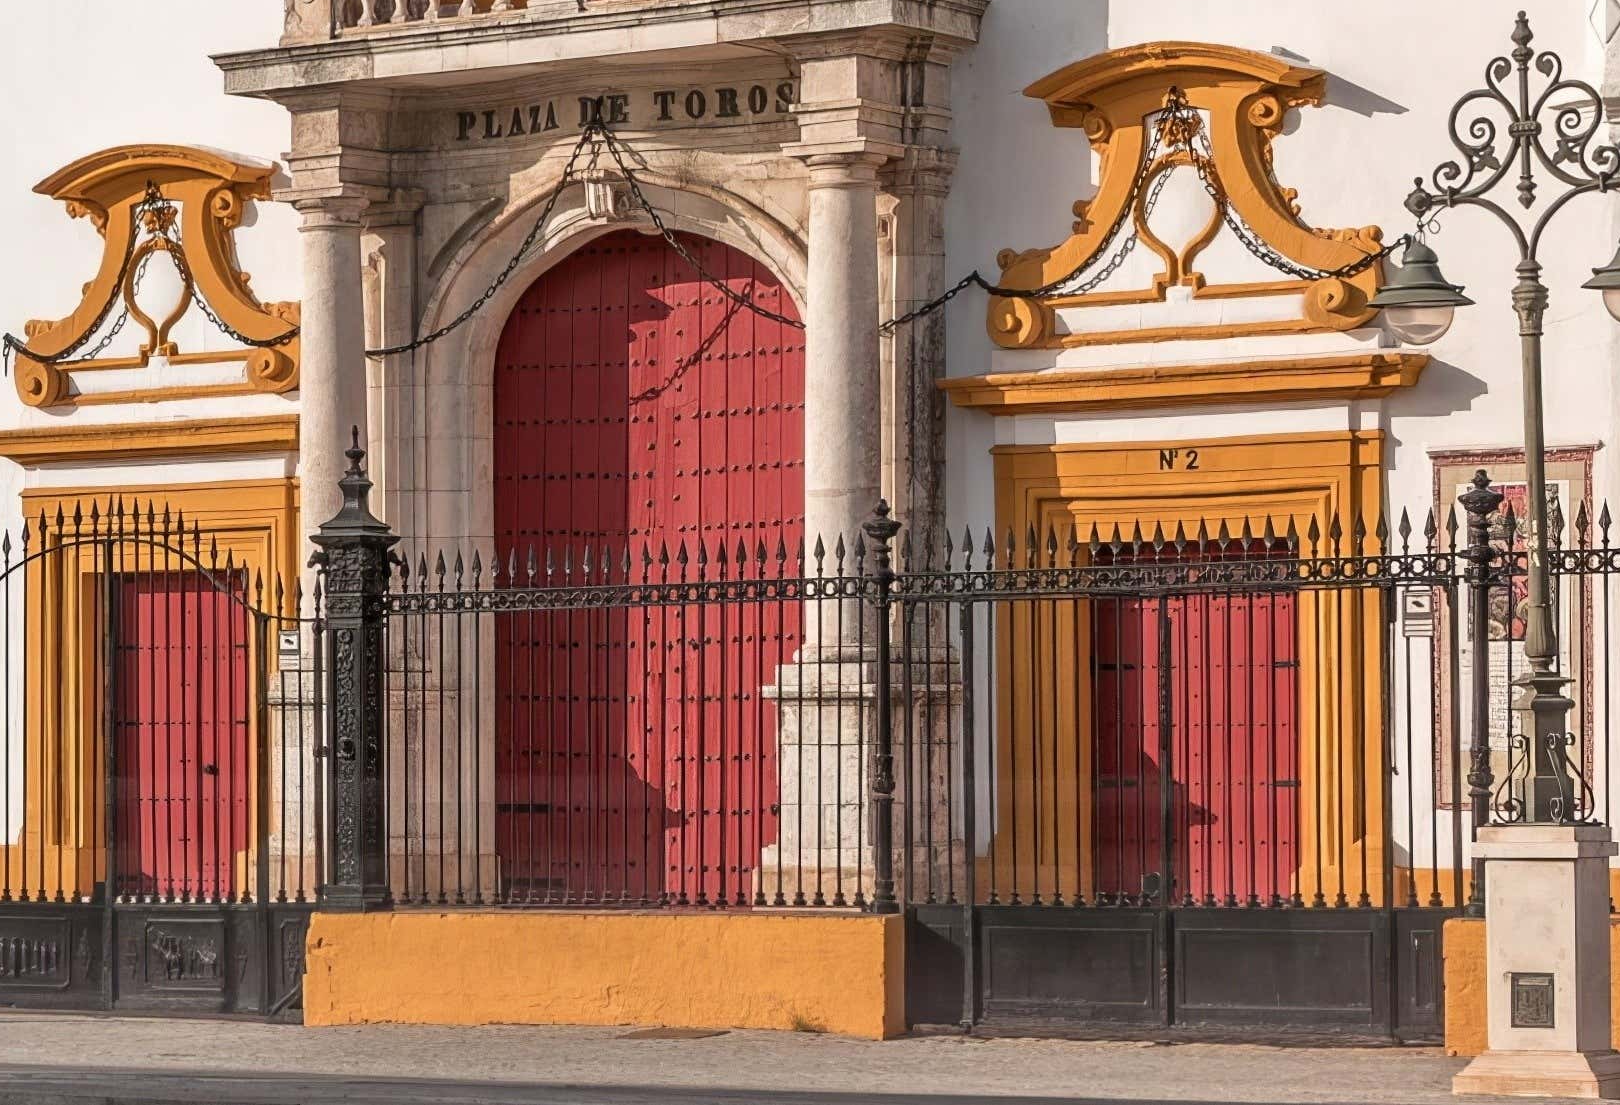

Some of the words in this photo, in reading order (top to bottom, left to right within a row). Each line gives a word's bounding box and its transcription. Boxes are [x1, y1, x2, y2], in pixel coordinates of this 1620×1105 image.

[455, 100, 560, 142] PLAZA
[578, 94, 630, 128] DE
[653, 81, 794, 122] TOROS
[1185, 448, 1200, 471] 2
